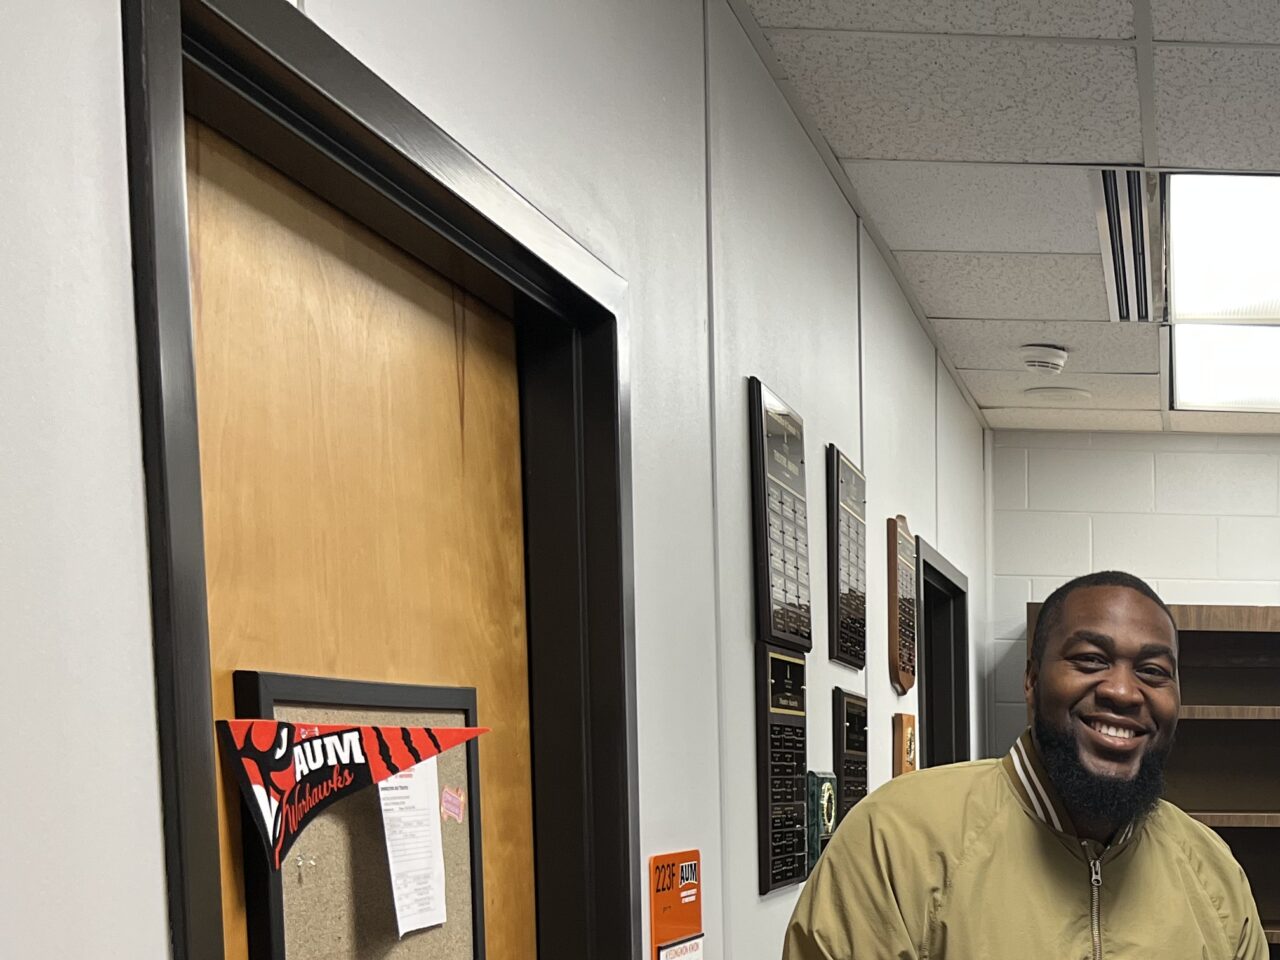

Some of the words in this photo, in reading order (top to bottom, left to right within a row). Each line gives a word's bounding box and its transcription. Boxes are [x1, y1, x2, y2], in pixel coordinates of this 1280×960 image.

[293, 731, 366, 782] AUM
[285, 763, 354, 834] Warhawks
[655, 862, 676, 893] 223F
[679, 861, 698, 888] AUM
